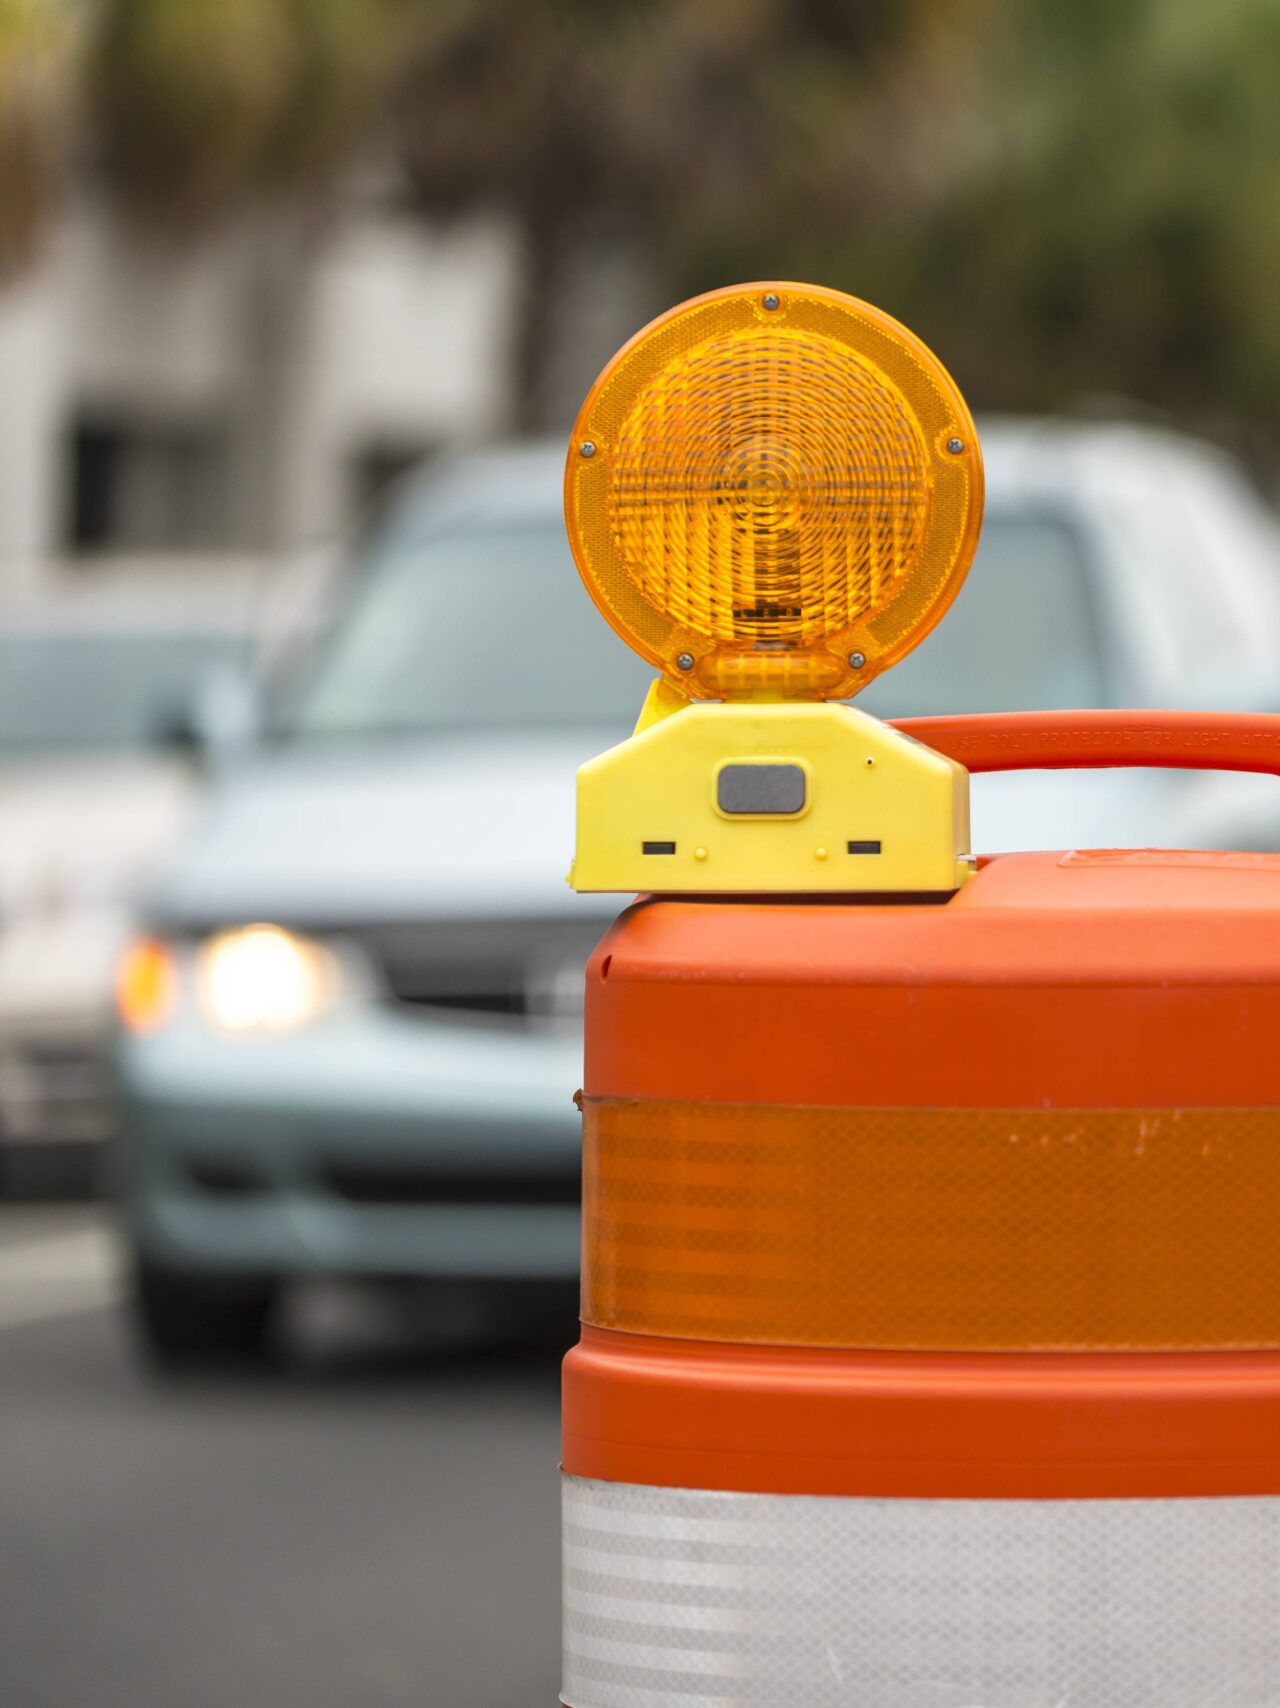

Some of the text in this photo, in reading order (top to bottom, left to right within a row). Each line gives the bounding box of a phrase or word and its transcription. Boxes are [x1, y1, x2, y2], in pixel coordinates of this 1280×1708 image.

[950, 735, 981, 751] USE
[989, 732, 1031, 749] BOLT
[1039, 730, 1133, 747] PROTECTOR
[1142, 730, 1175, 746] FOR
[1183, 732, 1232, 748] LIGHT
